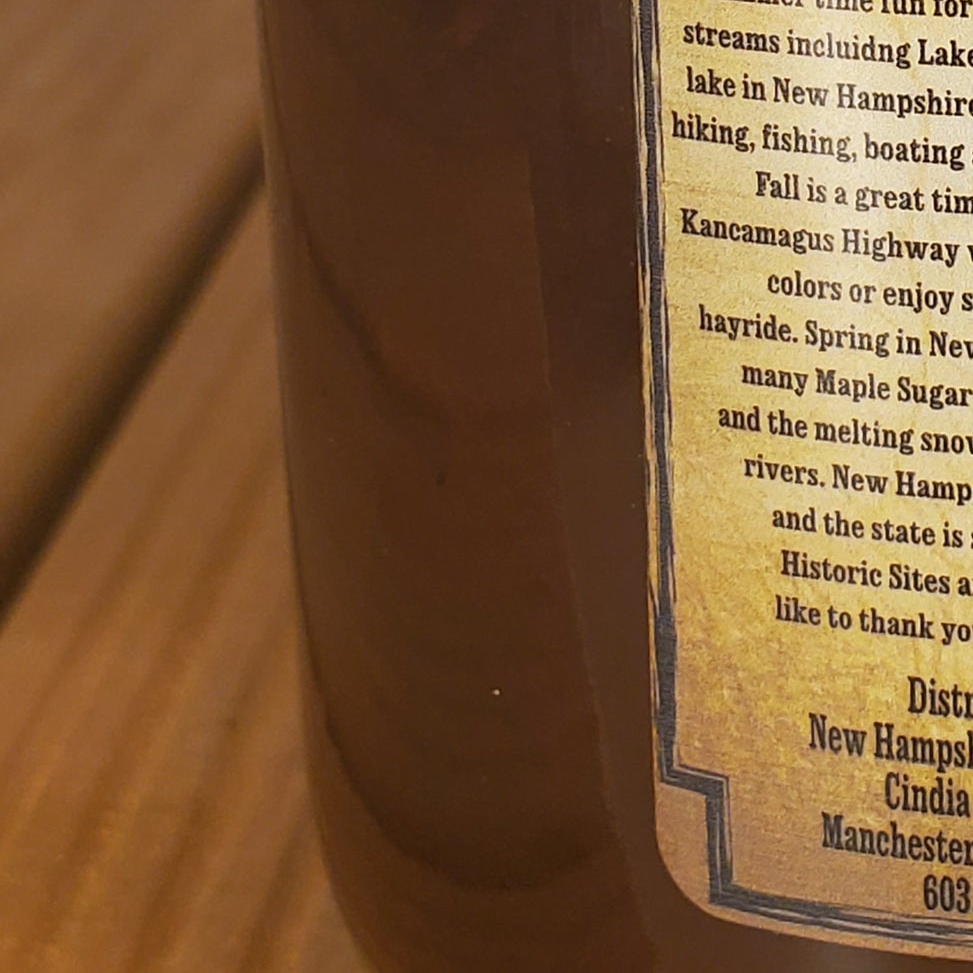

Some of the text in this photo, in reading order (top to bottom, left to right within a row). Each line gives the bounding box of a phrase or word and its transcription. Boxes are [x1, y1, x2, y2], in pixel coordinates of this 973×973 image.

[683, 22, 780, 53] streams
[787, 29, 911, 69] incluidng
[686, 66, 736, 97] lake
[773, 77, 828, 106] New
[672, 111, 755, 153] hiking,
[762, 124, 856, 162] fishing,
[864, 133, 965, 171] boating
[756, 171, 800, 200] Fall
[856, 187, 925, 211] great
[680, 208, 834, 254] Kancamagus
[842, 229, 959, 268] Highway
[768, 270, 841, 300] colors
[883, 282, 954, 315] enjoy
[699, 304, 798, 343] hayride.
[805, 320, 889, 358] Spring
[742, 365, 808, 397] many
[815, 368, 890, 402] Maple
[897, 376, 973, 410] Sugar
[767, 410, 808, 439] the
[814, 419, 914, 455] melting
[744, 454, 825, 487] rivers.
[832, 464, 888, 494] New
[772, 507, 816, 532] and
[823, 511, 864, 538] the
[871, 520, 935, 546] state
[781, 550, 882, 587] Historic
[889, 564, 950, 594] Sites
[776, 595, 821, 625] like
[859, 608, 935, 639] thank
[809, 713, 867, 756] New
[885, 772, 970, 818] Cindia
